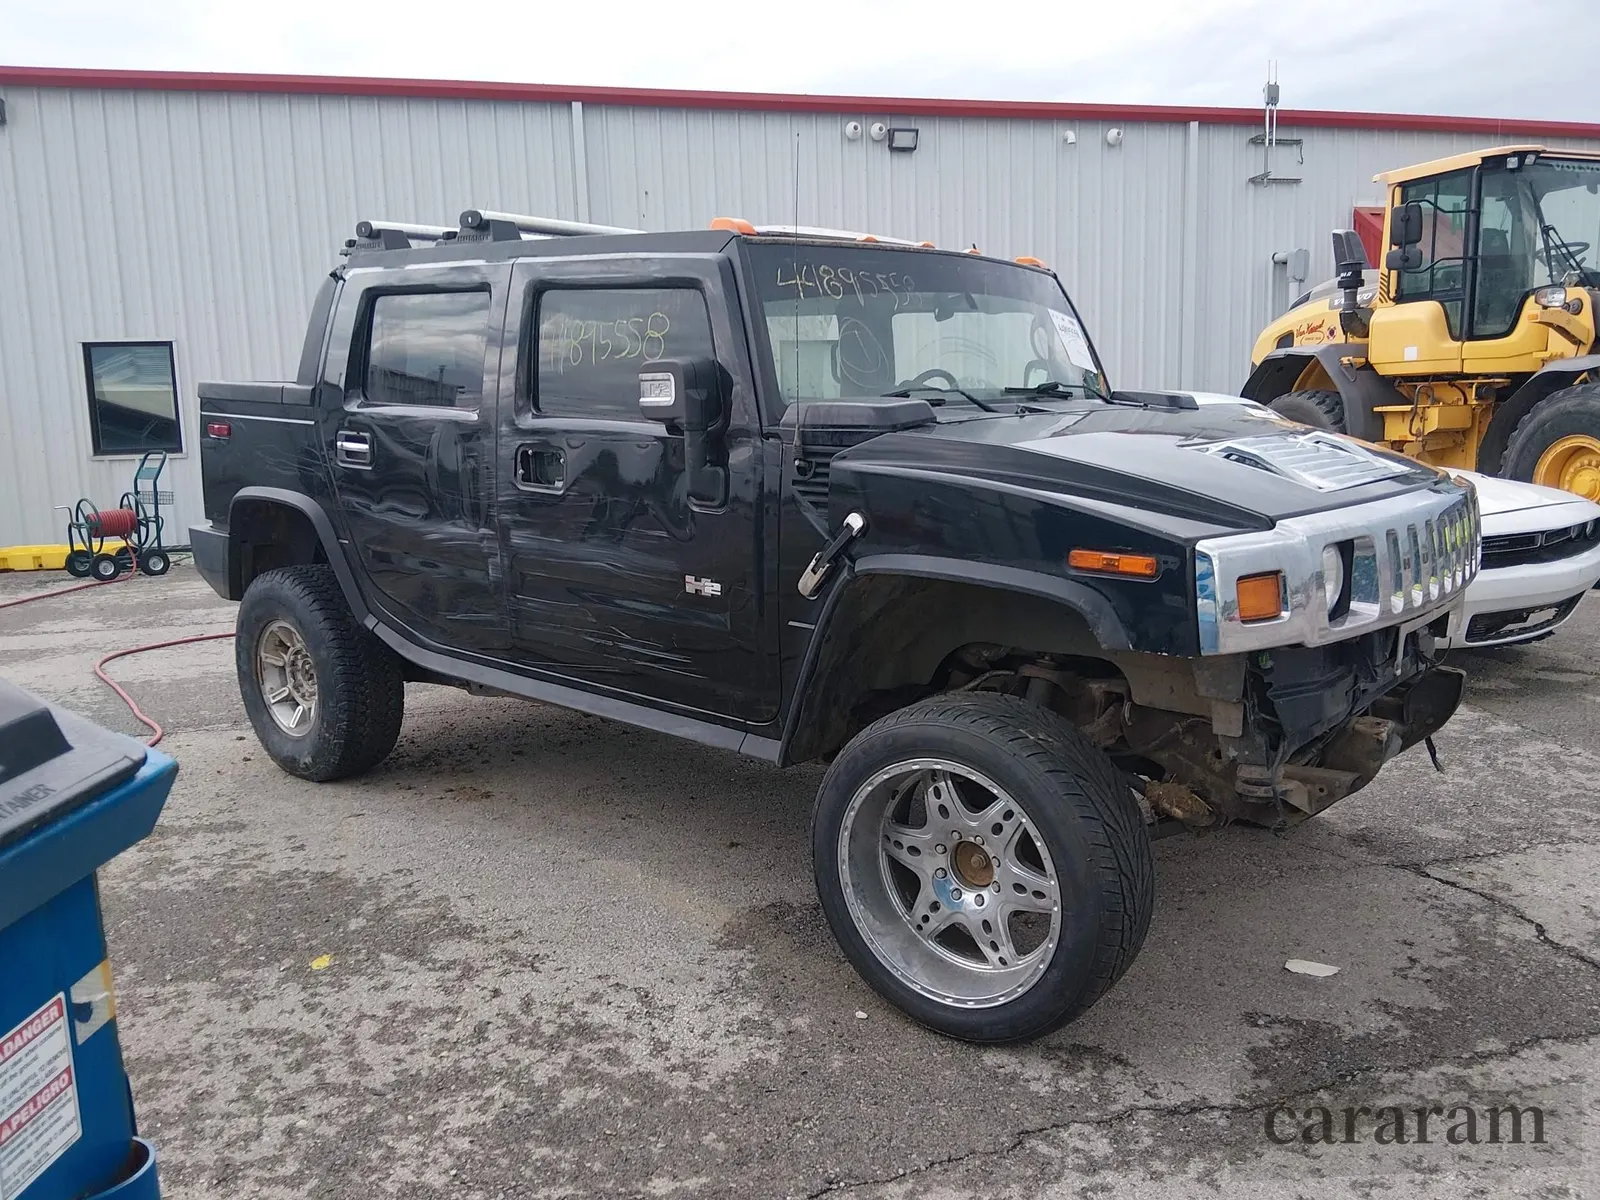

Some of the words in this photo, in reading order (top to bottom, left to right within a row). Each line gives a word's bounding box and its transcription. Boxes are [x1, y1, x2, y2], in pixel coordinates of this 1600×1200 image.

[1334, 292, 1373, 306] VVO
[685, 574, 721, 596] H2
[3, 1005, 60, 1059] DANGER
[9, 1072, 69, 1131] PELIGRO
